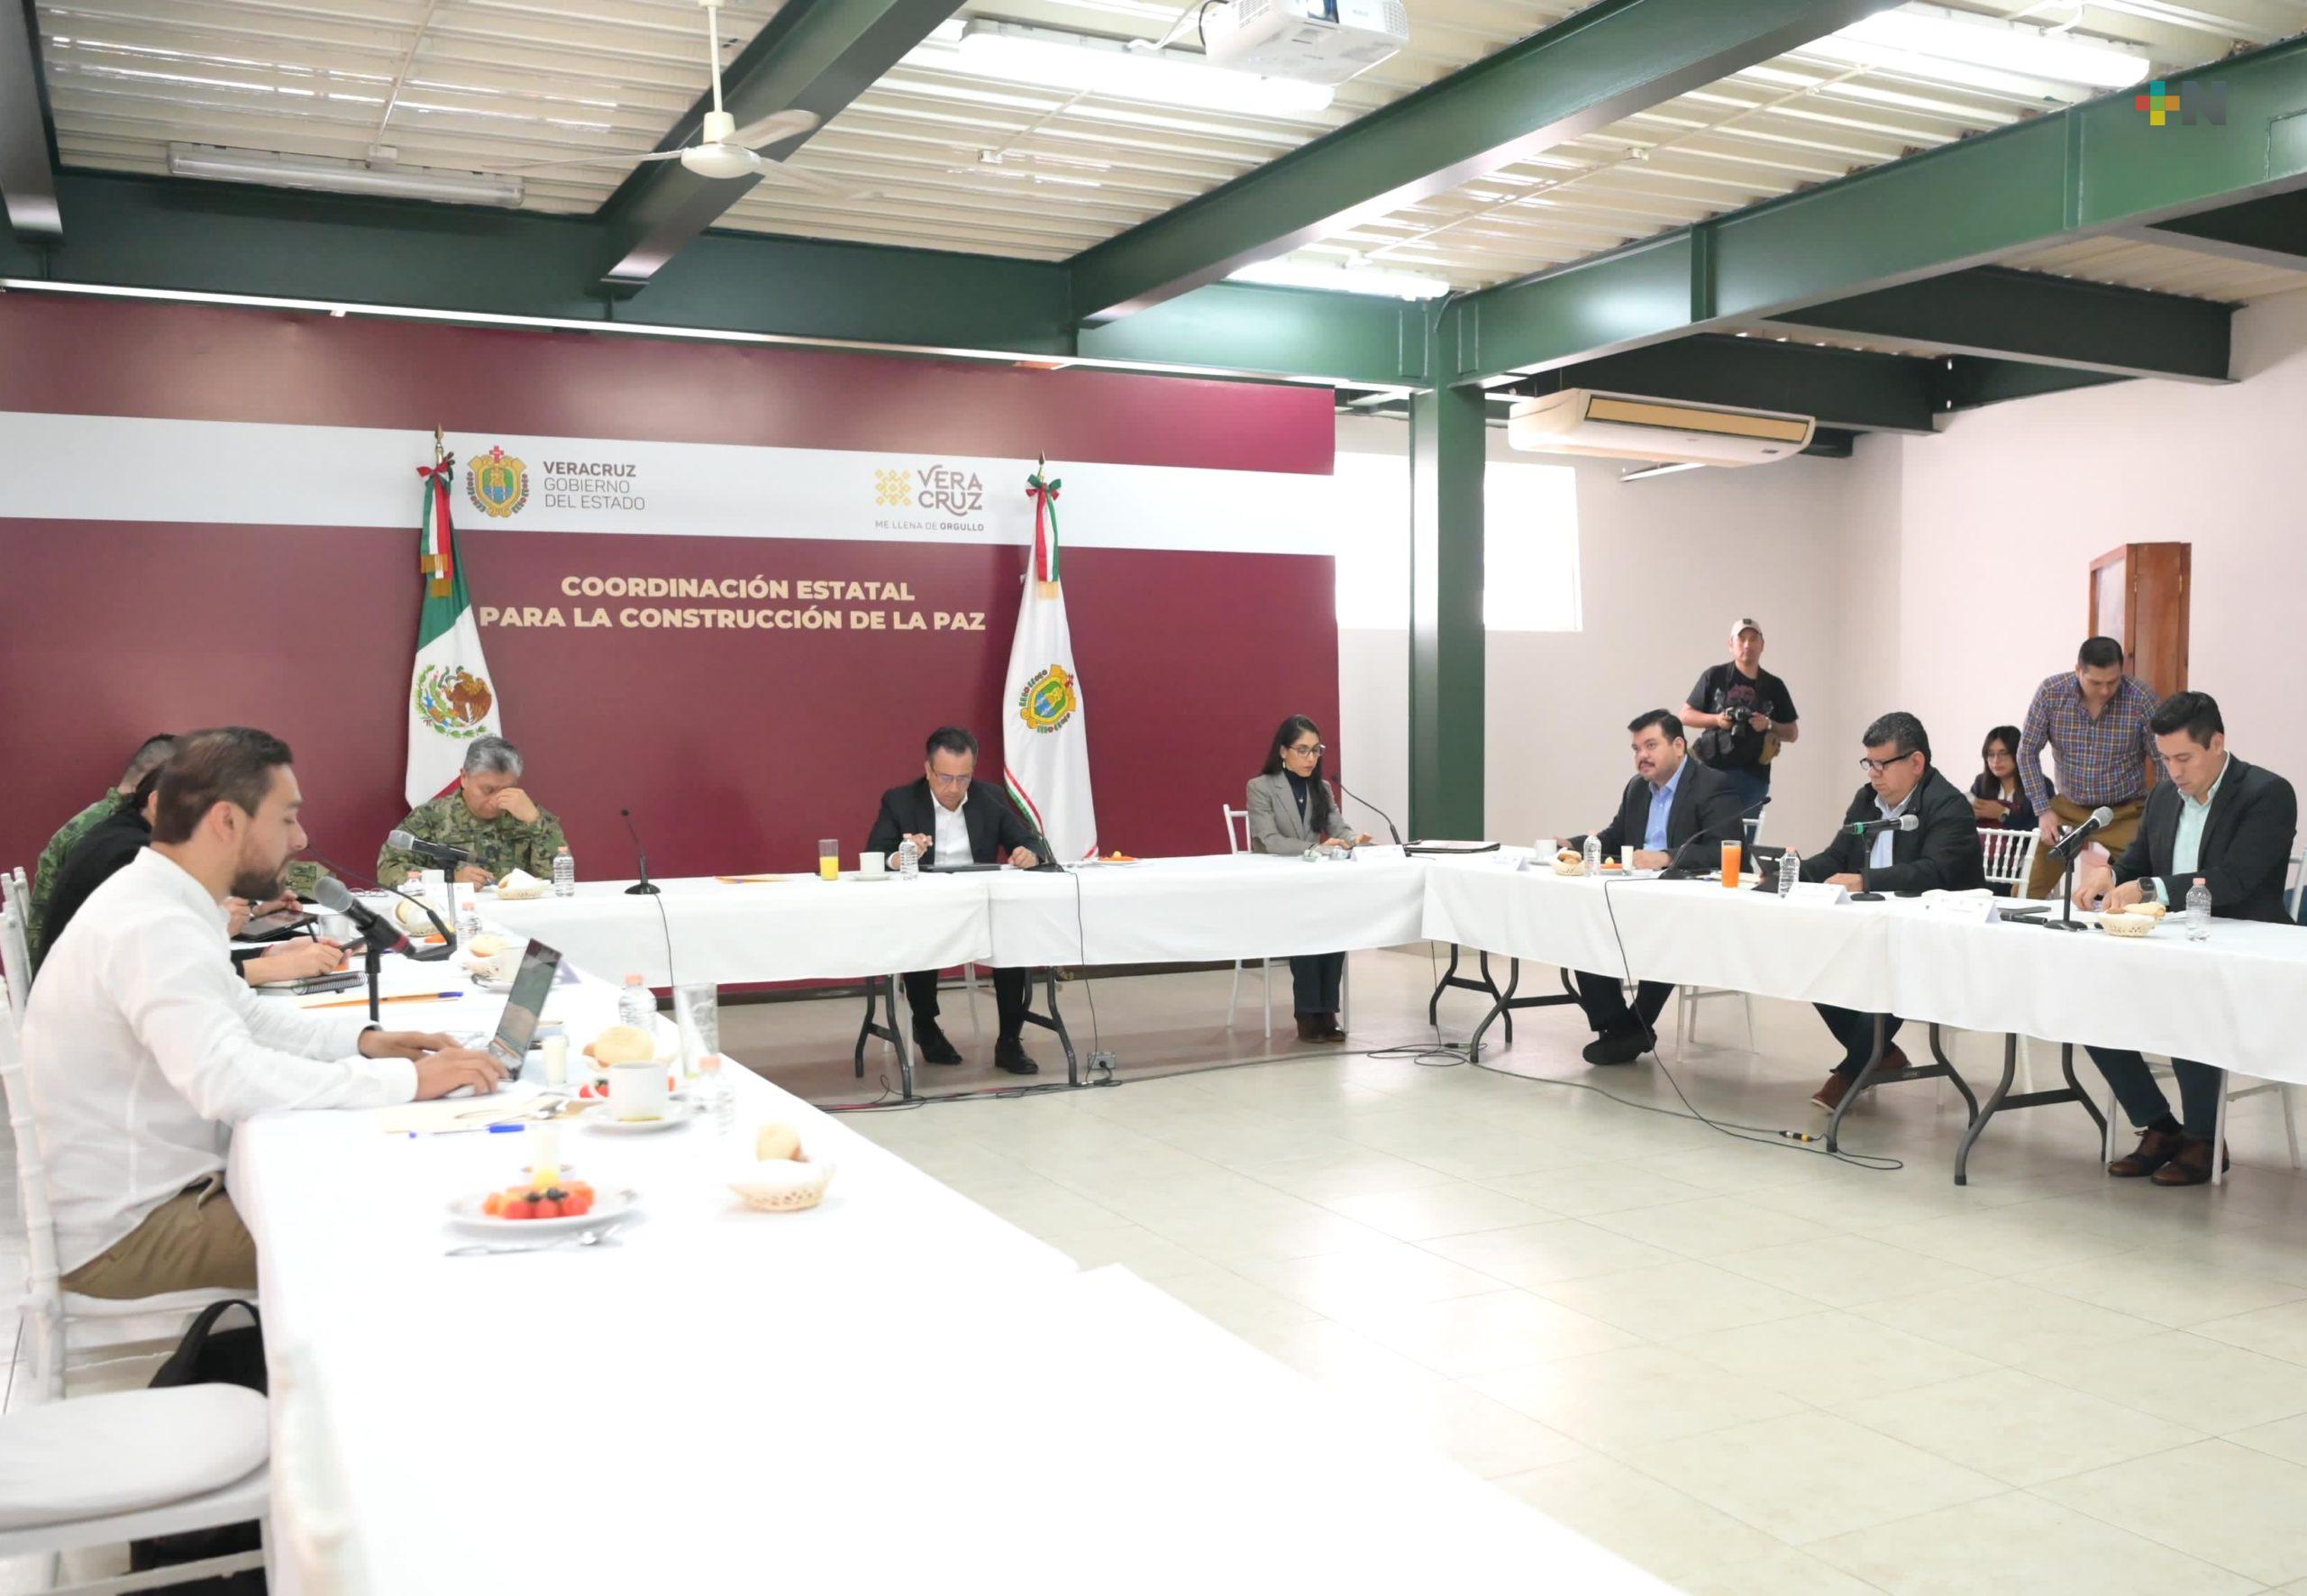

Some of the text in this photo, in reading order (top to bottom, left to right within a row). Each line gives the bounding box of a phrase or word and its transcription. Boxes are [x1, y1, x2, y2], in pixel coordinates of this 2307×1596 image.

[543, 461, 636, 477] VERACRUZ
[917, 464, 983, 491] VERA
[543, 478, 630, 494] GOBIERNO
[544, 494, 645, 511] DEL ESTADO
[917, 490, 983, 516] CRUZ
[875, 520, 984, 532] ME LLENA DE ORGULLO
[561, 574, 915, 601] COORDINACIÓN ESTATAL
[479, 606, 986, 631] PARA LA CONSTRUCCIÓN DE LA PAZ
